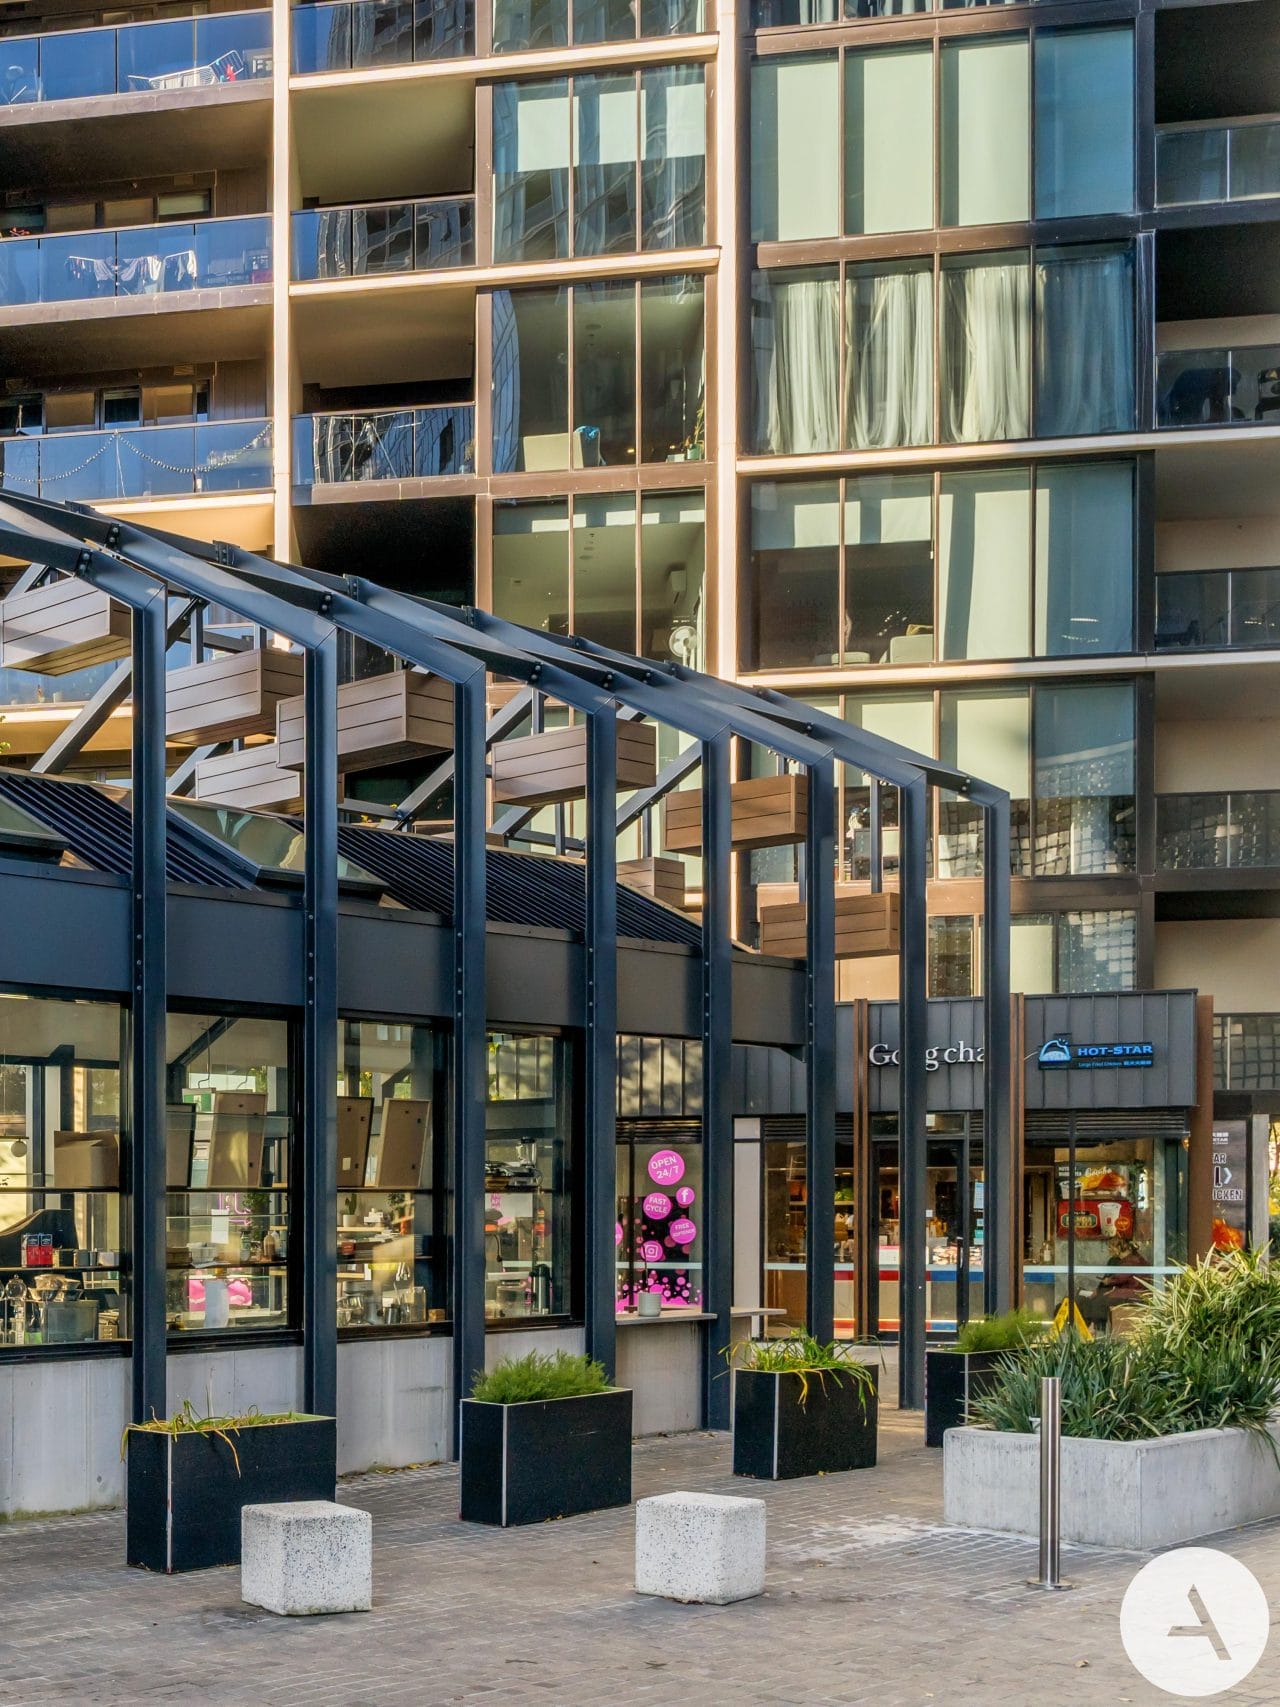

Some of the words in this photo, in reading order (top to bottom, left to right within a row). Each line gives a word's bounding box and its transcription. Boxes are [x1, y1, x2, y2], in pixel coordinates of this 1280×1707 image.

[1077, 1045, 1153, 1056] HOT-STAR
[869, 1043, 939, 1071] Gog
[651, 1156, 677, 1169] OPEN
[656, 1166, 679, 1179] 24/7
[1213, 1190, 1242, 1200] ICKEN
[649, 1197, 667, 1205] FAST
[645, 1204, 668, 1214] CYCLE
